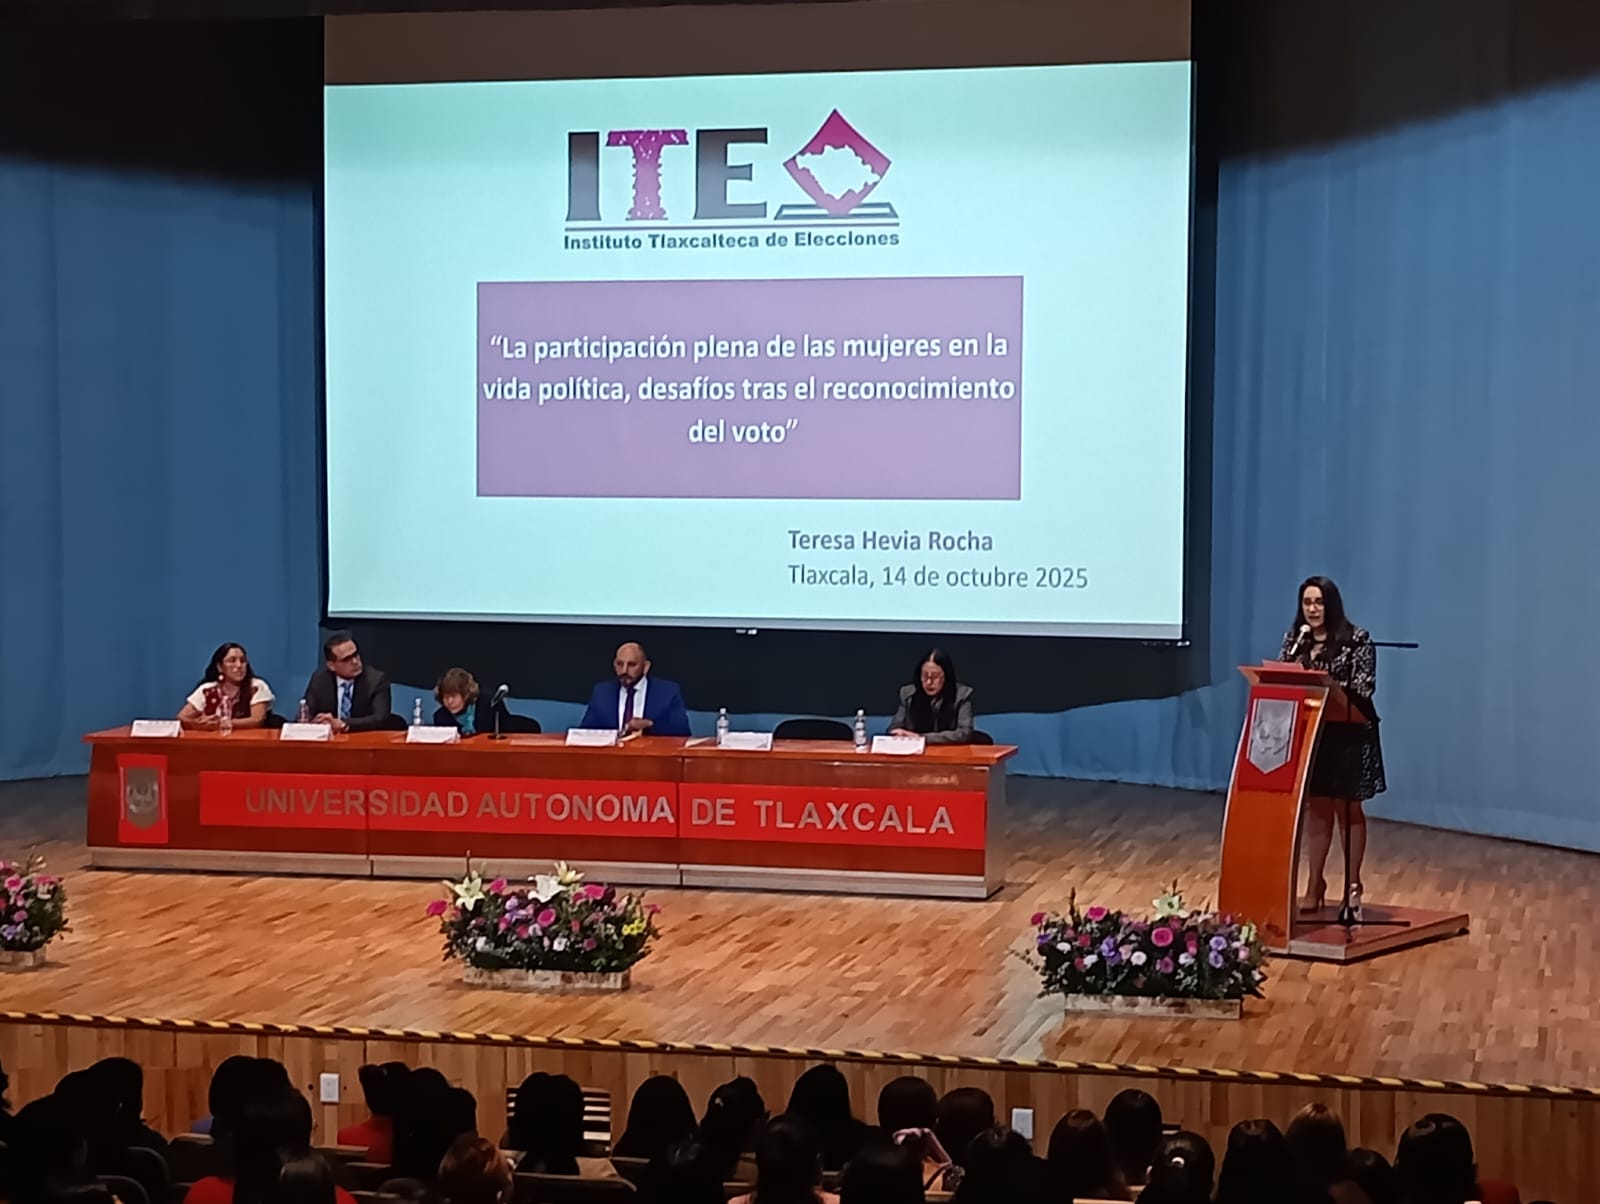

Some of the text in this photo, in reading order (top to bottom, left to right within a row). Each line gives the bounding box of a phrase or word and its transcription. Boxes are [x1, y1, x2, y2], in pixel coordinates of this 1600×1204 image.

[566, 127, 768, 221] ITE
[564, 231, 900, 250] Instituto Tlaxcalteca de Elecciones
[490, 332, 1008, 364] “La participación plena de las mujeres en la
[483, 376, 1015, 405] vida política, desafíos tras el reconocimiento
[688, 418, 798, 443] del voto”
[788, 530, 993, 551] Teresa Hevia Rocha
[788, 563, 1088, 589] Tlaxcala, 14 de octubre 2025
[246, 788, 955, 835] UNIVERSIDAD AUTONOMA DE TLAXCALA
